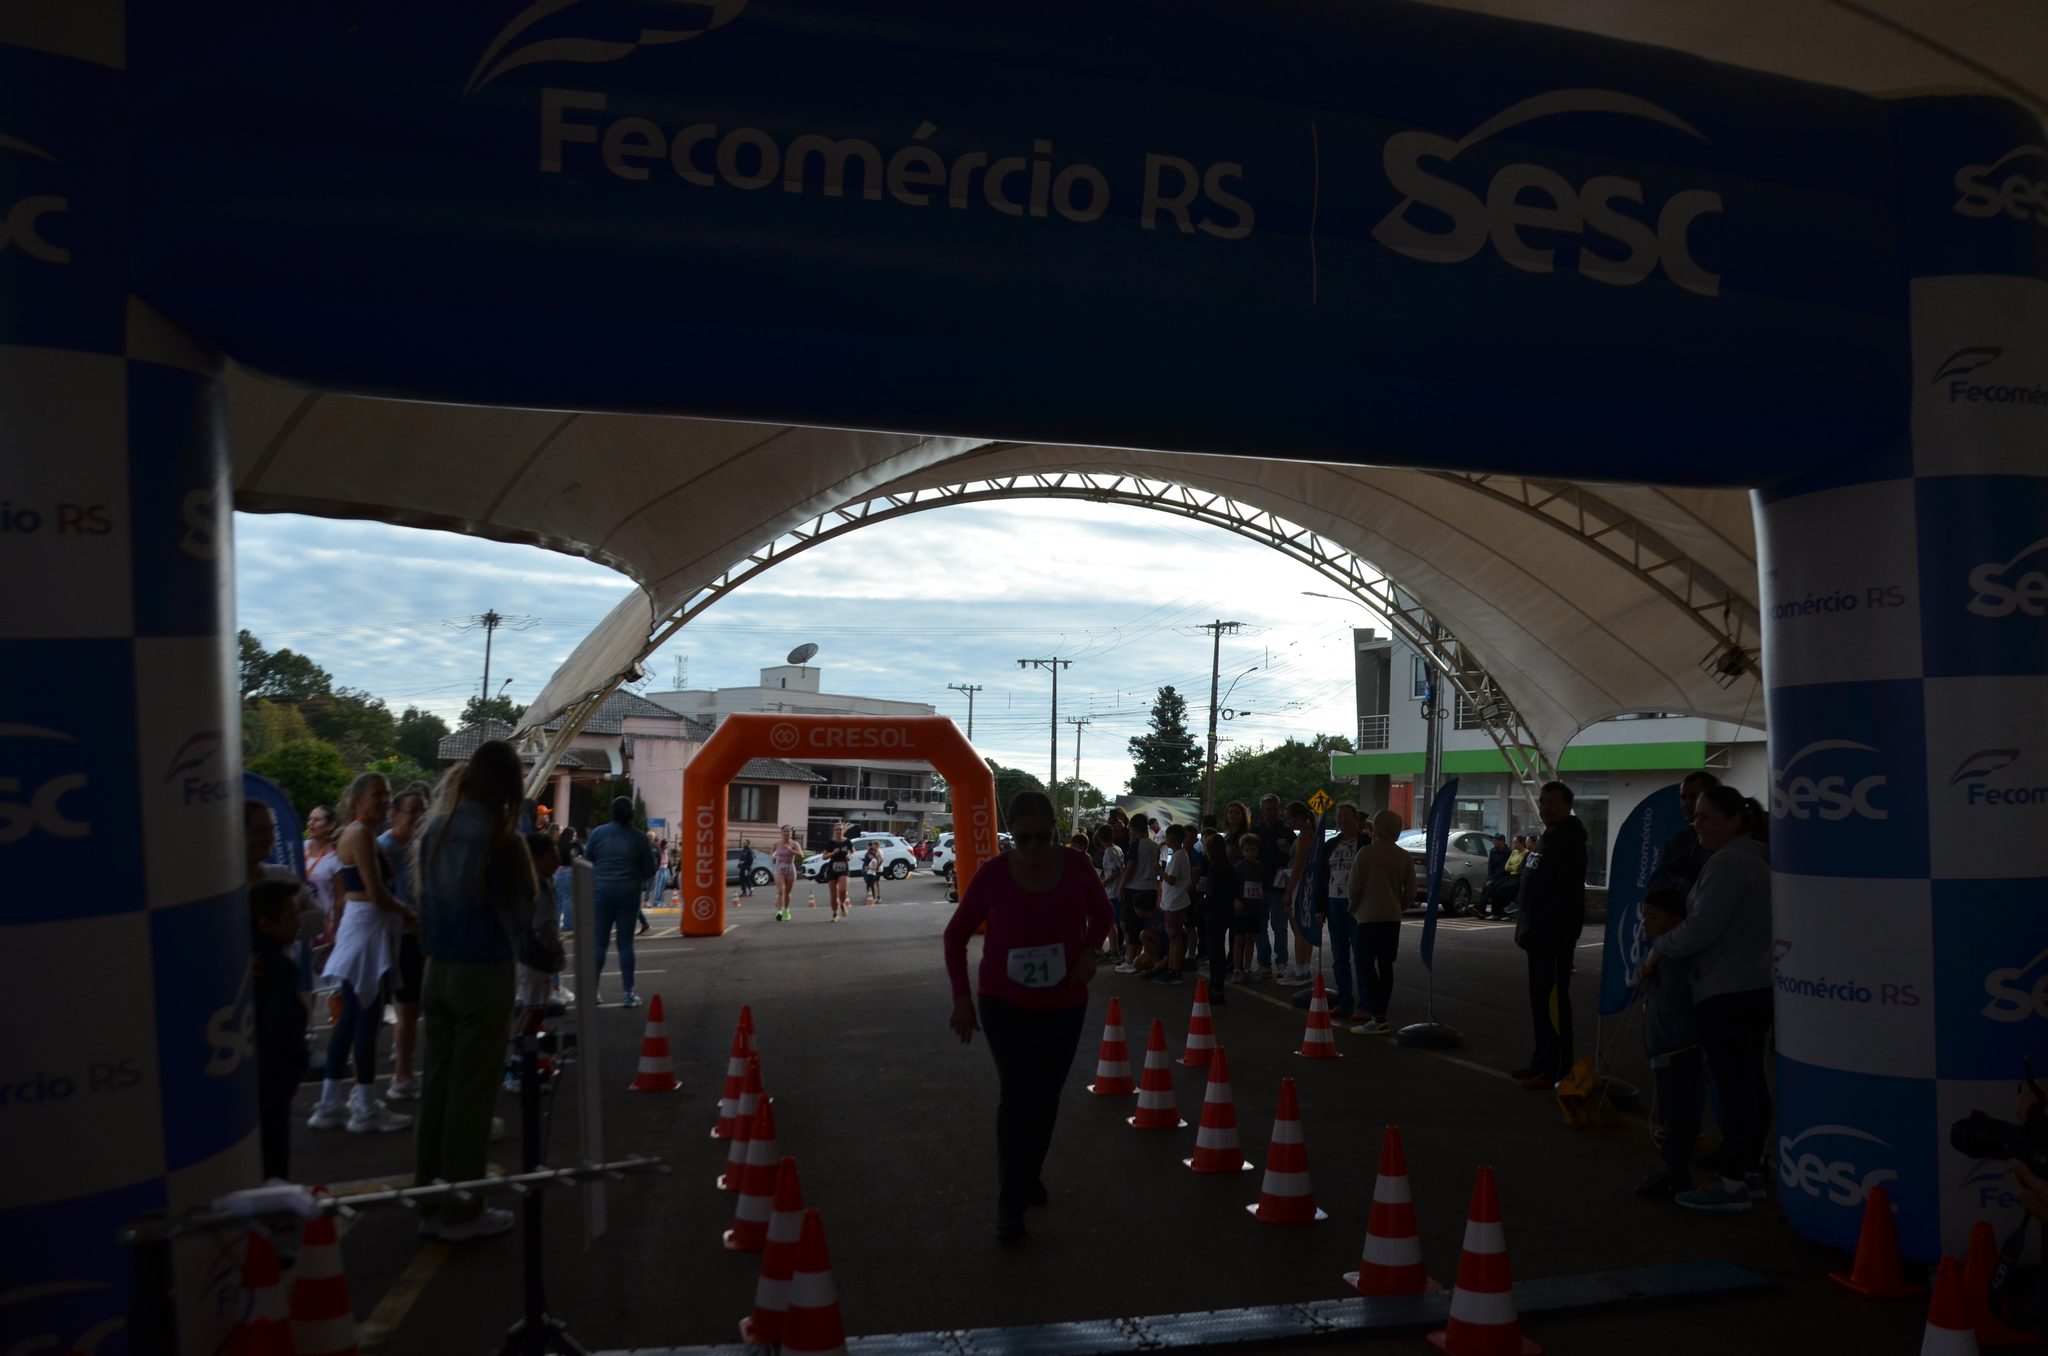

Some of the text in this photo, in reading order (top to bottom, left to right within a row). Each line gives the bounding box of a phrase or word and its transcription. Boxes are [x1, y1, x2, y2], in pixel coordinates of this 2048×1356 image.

[540, 87, 1255, 240] Fecomércio RS
[1370, 120, 1724, 297] Sesc
[57, 504, 113, 536] RS
[1866, 585, 1905, 608] RS
[809, 727, 915, 749] CRESOL
[695, 799, 715, 889] CRESOL
[971, 796, 992, 868] RESOL
[1023, 960, 1049, 984] 21
[1881, 983, 1921, 1007] RS
[88, 1057, 142, 1093] RS
